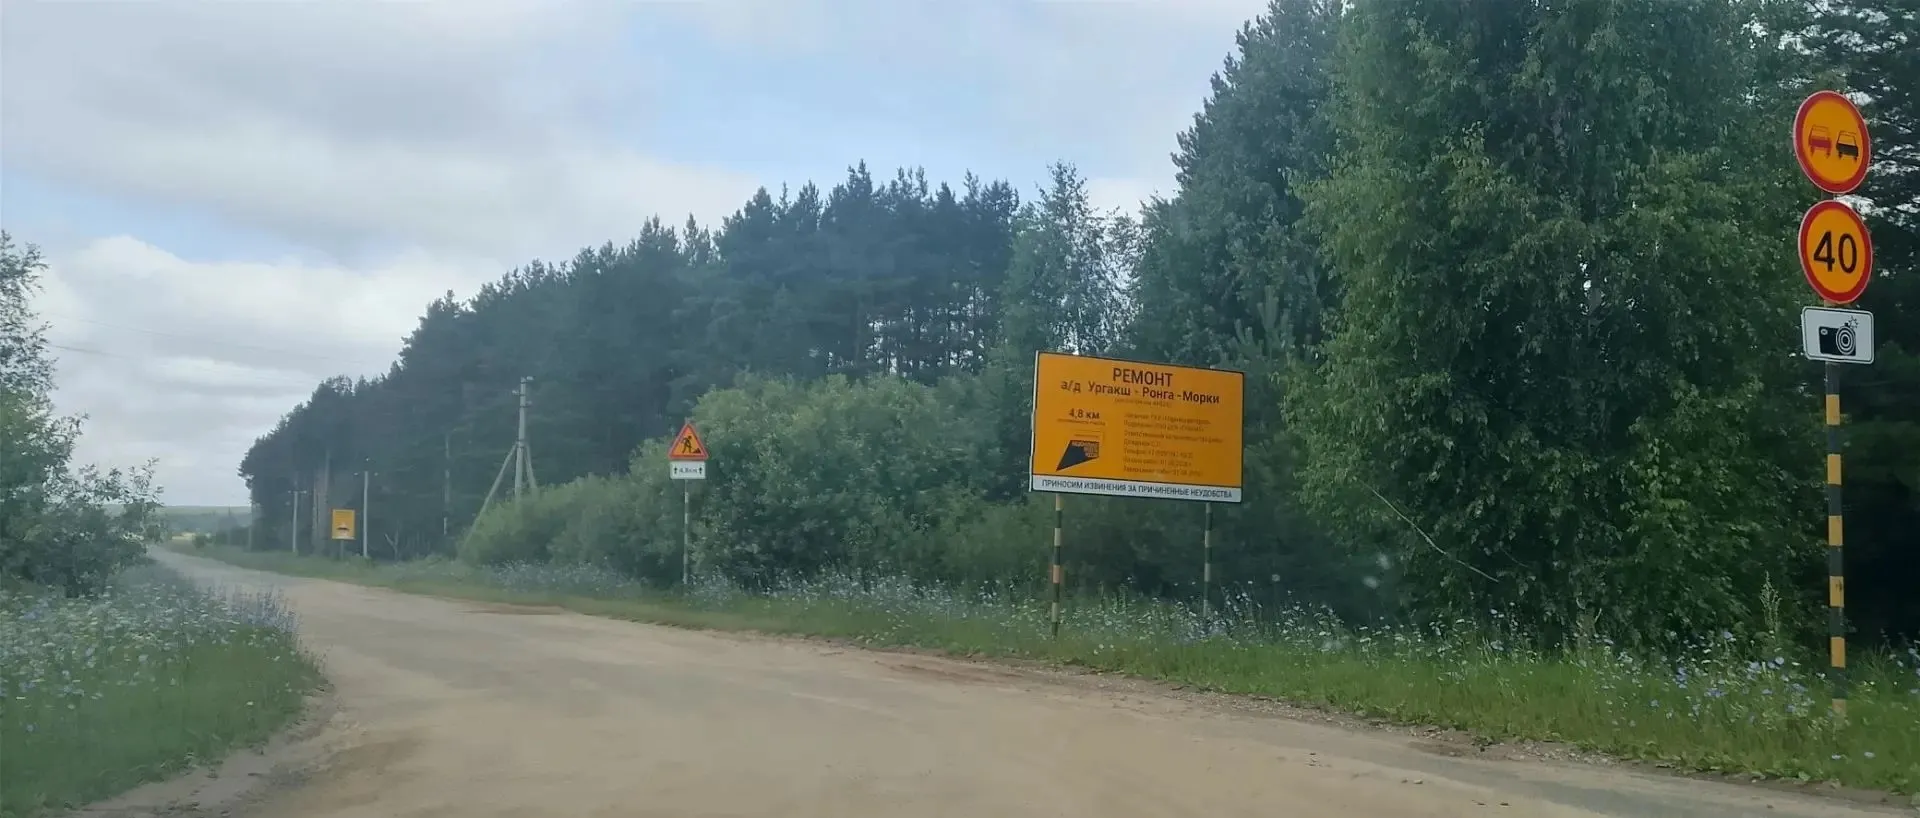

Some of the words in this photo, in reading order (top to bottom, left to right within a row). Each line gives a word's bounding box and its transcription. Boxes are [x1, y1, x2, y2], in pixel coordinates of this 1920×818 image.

[1813, 230, 1858, 274] 40
[1112, 367, 1173, 387] РЕМОНТ
[1060, 380, 1081, 394] а/д
[1087, 380, 1131, 397] Ургакш
[1142, 387, 1175, 400] Ронга
[1069, 408, 1084, 419] 4,8
[1086, 411, 1100, 420] км
[1041, 479, 1083, 490] ПРИНОСИМ
[1083, 480, 1127, 492] ИЗВИНЕНИЯ
[1127, 482, 1137, 493] ЗА
[1138, 483, 1190, 496] ПРИЧИНЕННЫЕ
[1190, 487, 1232, 499] НЕУДОБСТВА
